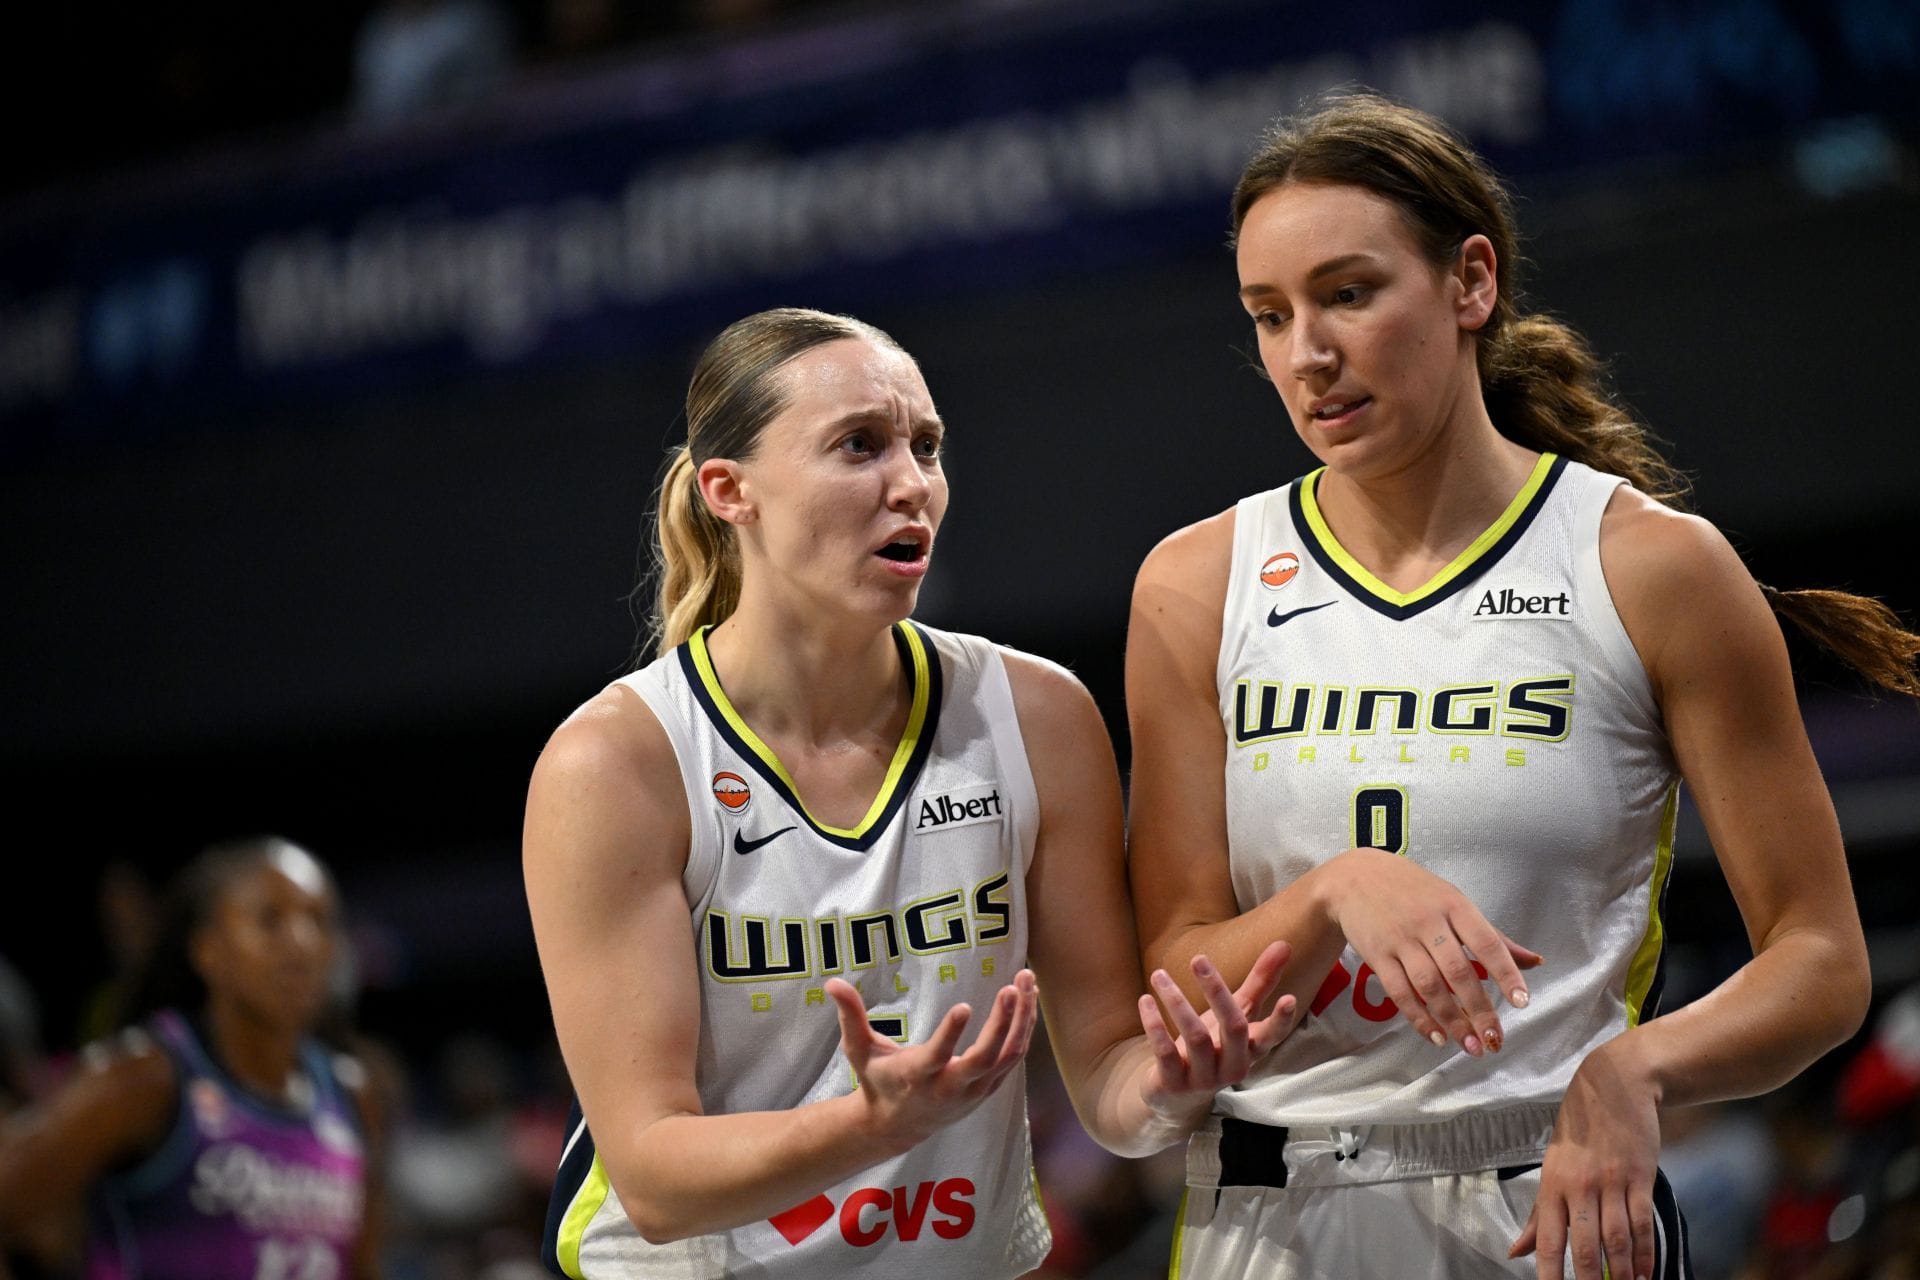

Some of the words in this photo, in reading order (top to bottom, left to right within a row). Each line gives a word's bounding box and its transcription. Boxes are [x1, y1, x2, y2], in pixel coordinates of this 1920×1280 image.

[1473, 588, 1570, 616] Albert
[1234, 673, 1576, 748] WINGS
[1253, 744, 1526, 771] DALLAS
[916, 789, 1002, 829] Albert
[1350, 783, 1409, 856] 0
[705, 867, 1010, 983] WINGS
[839, 1177, 976, 1247] CVS
